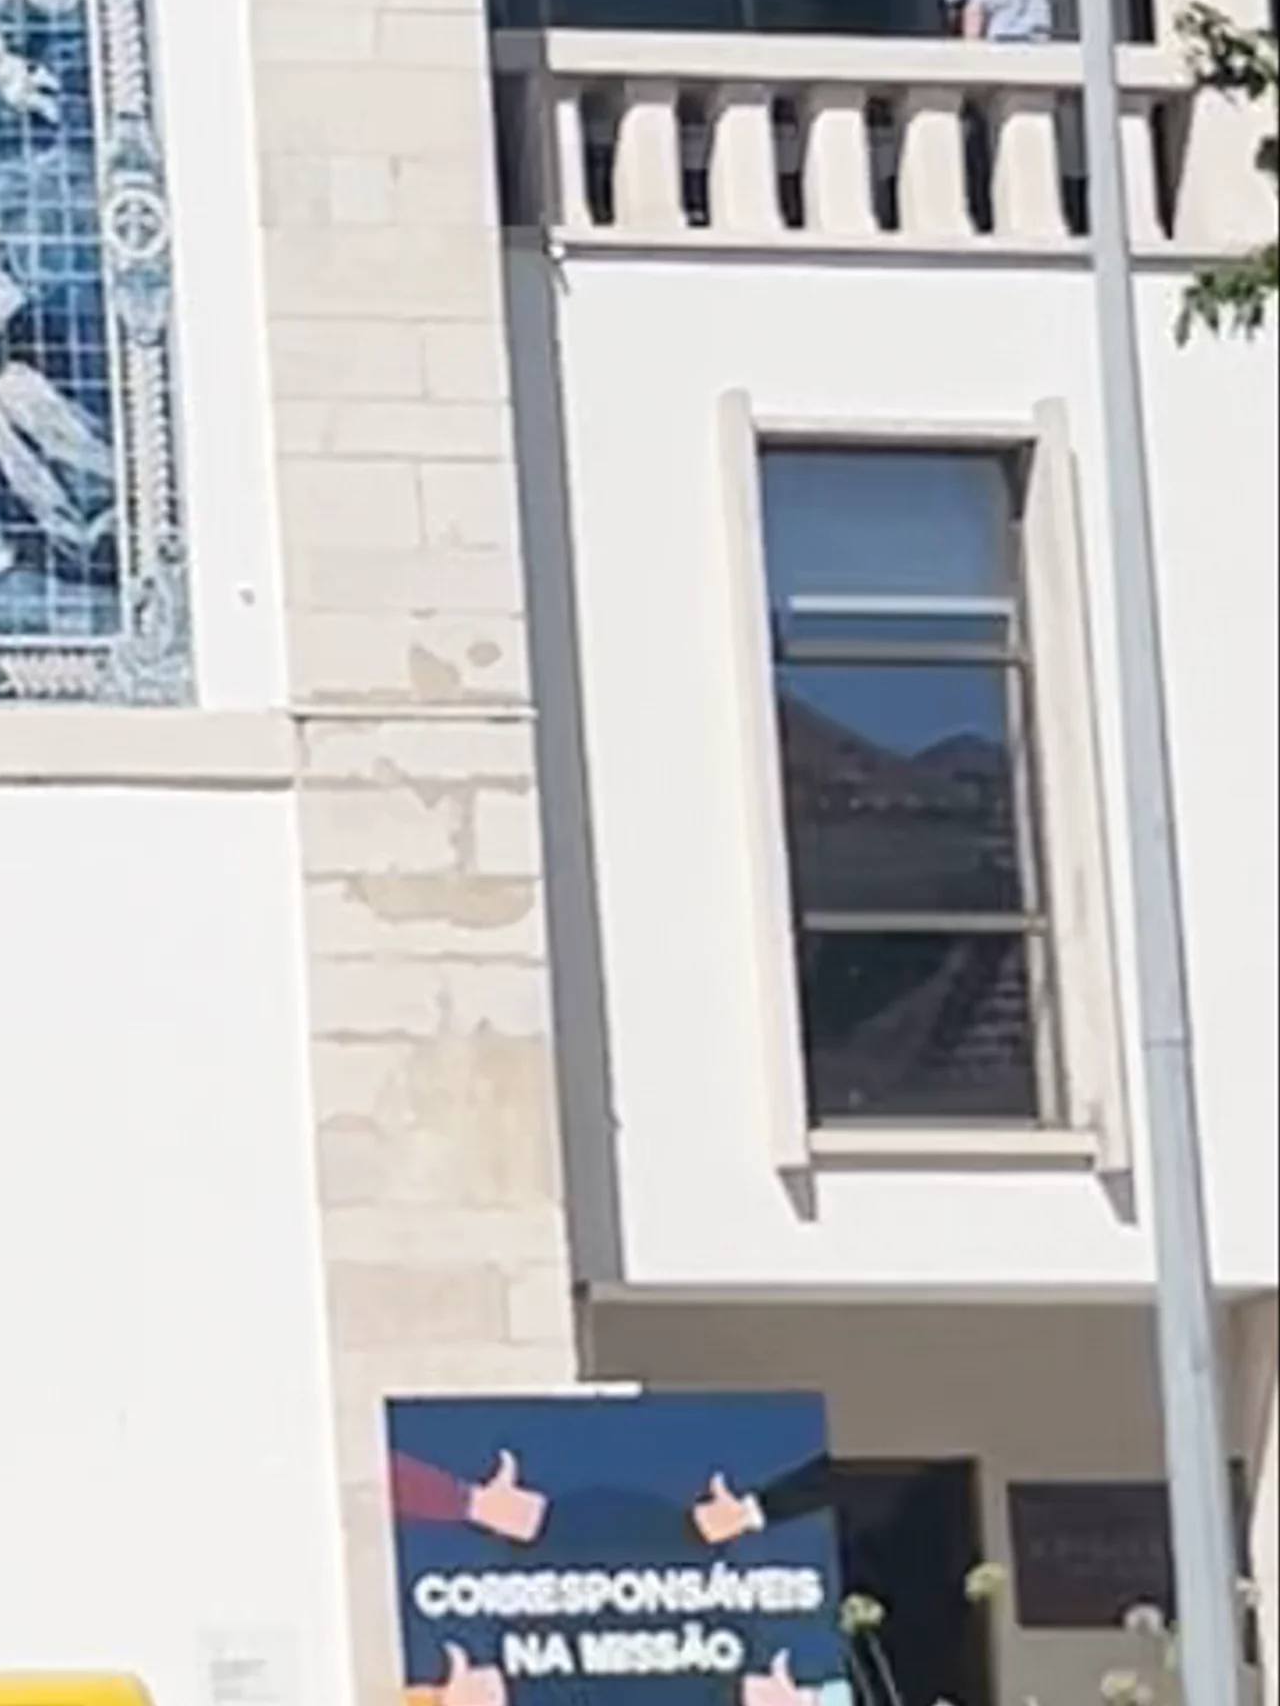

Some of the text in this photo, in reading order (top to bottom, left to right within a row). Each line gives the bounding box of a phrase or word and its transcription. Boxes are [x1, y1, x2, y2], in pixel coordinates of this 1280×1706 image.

[414, 1560, 824, 1618] CORRESPONSÁVEIS
[502, 1620, 744, 1675] NA MISSÃO
